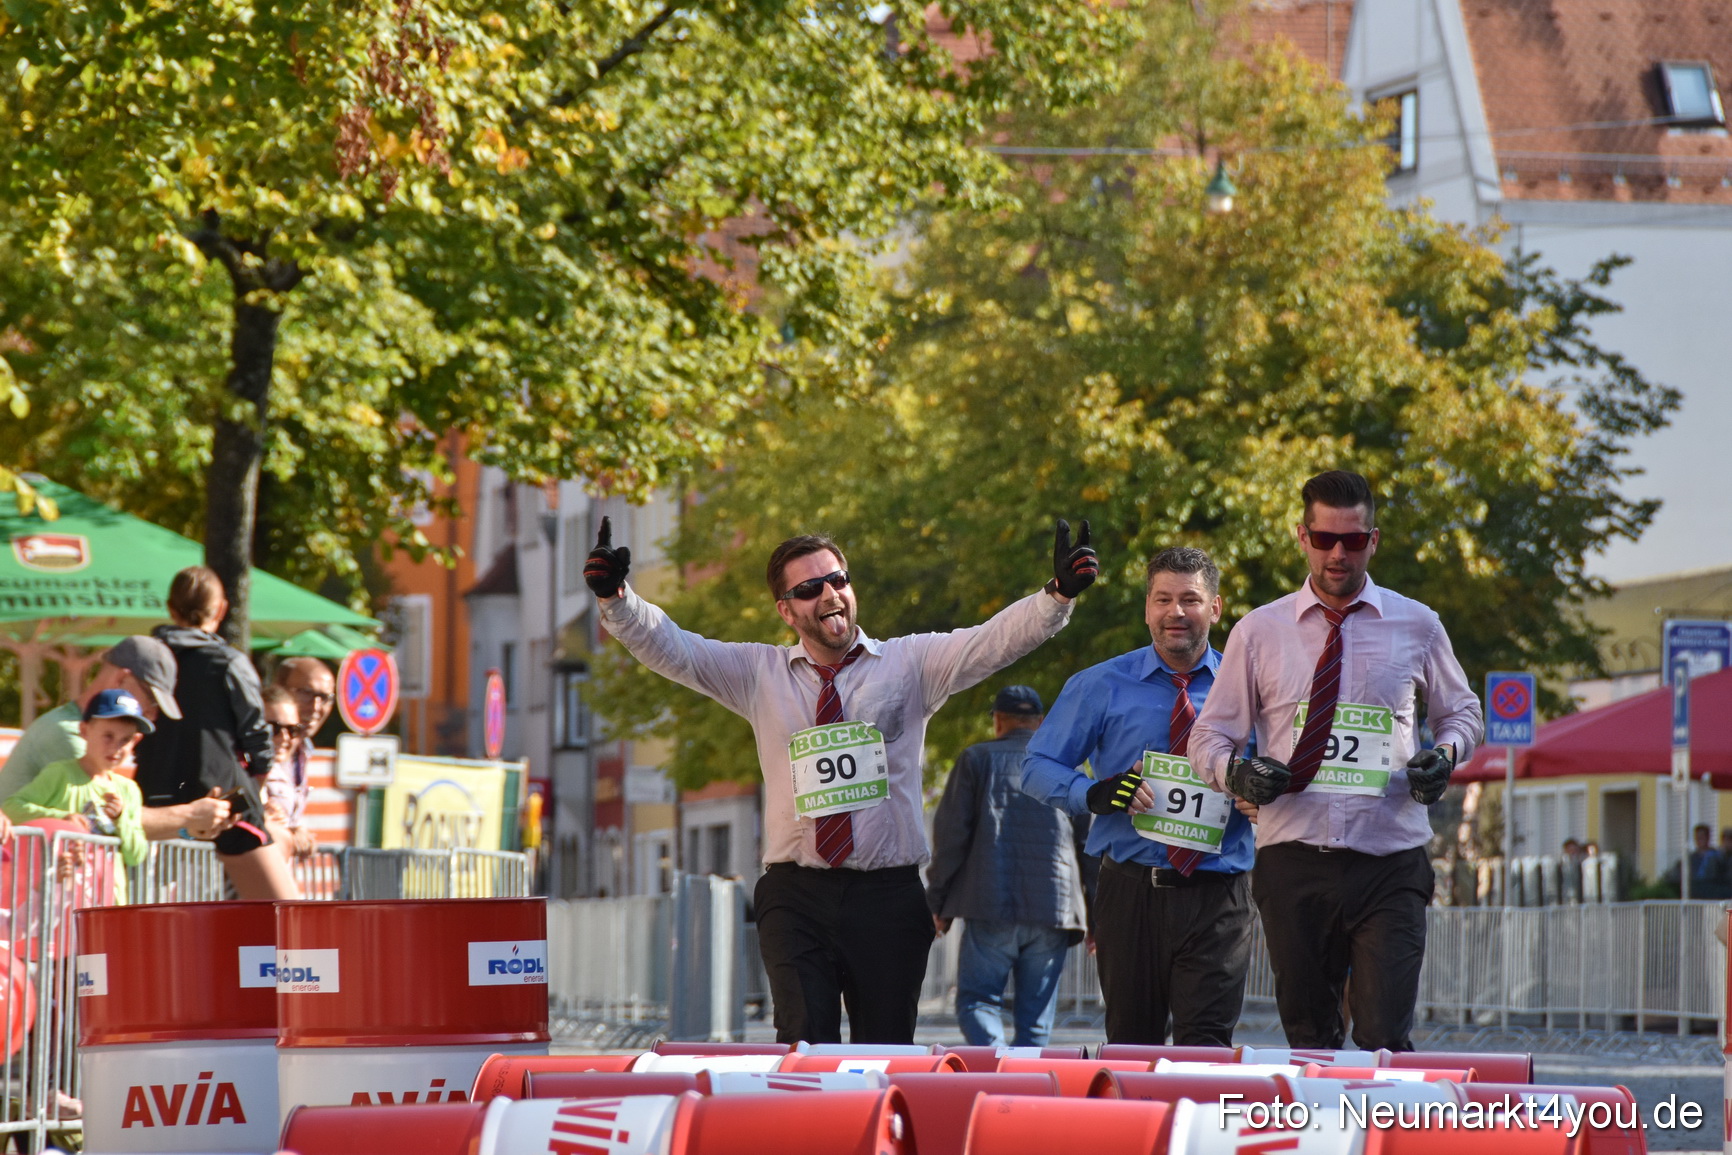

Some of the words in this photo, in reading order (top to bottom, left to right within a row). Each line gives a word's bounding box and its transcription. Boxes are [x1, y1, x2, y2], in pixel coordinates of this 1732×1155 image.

[794, 725, 874, 756] BOCK
[1493, 722, 1530, 739] TAXI
[1323, 734, 1359, 763] 92
[816, 753, 857, 784] 90
[1315, 769, 1365, 784] MARIO
[804, 784, 879, 809] MATTHIAS
[1166, 788, 1204, 818] 91
[1153, 820, 1209, 841] ADRIAN
